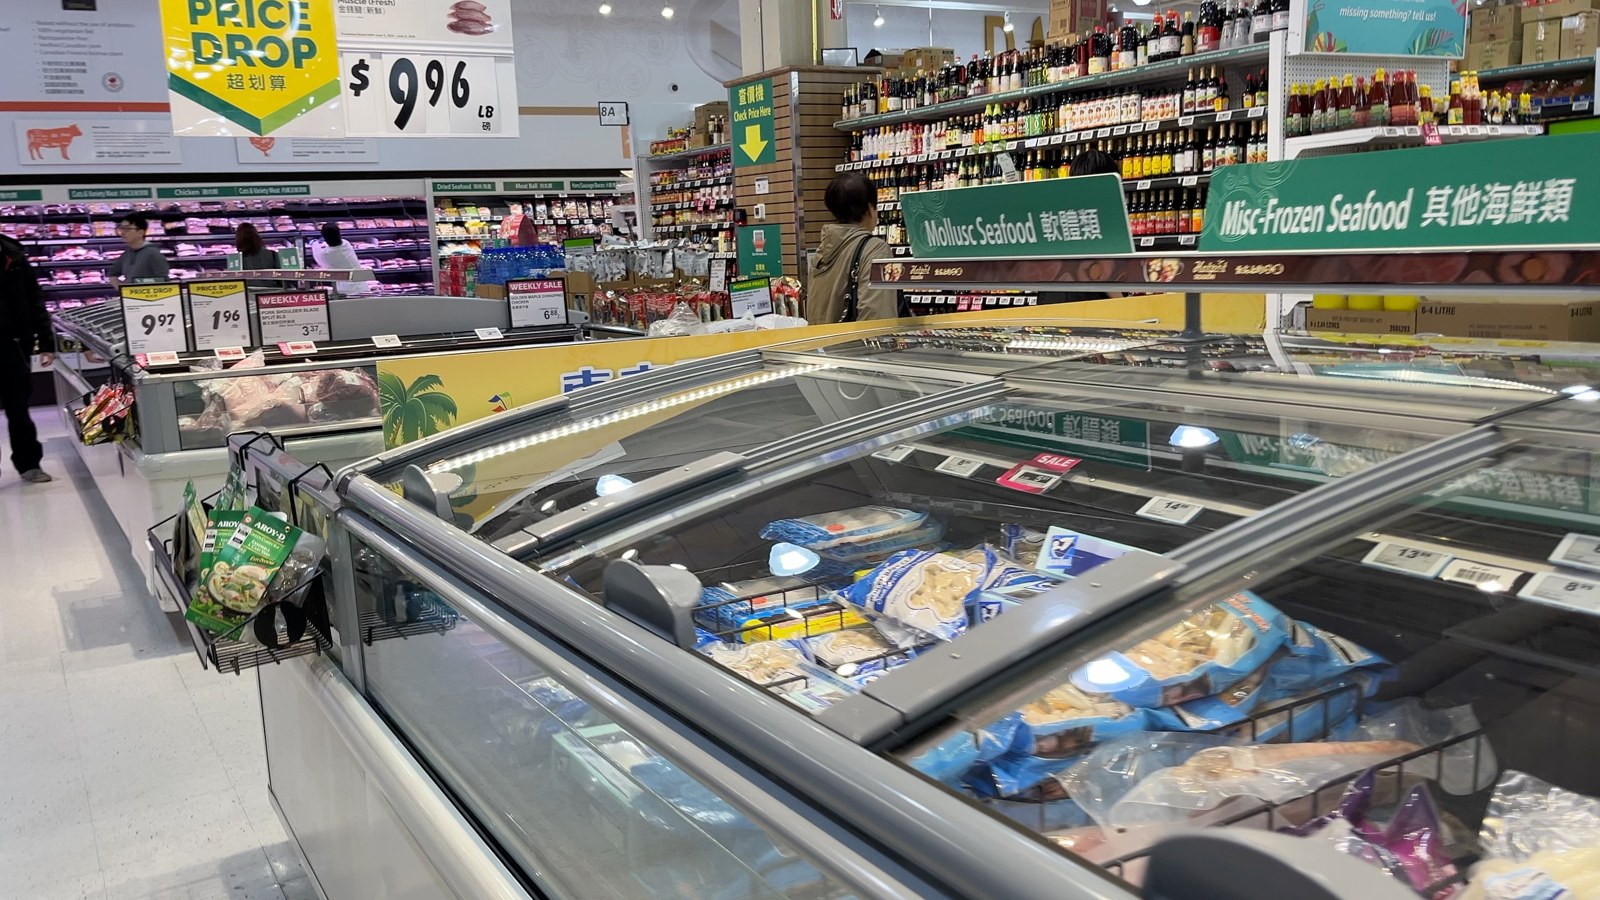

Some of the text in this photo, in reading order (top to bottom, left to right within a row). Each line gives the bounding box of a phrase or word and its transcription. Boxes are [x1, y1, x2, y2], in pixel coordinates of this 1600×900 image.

[188, 0, 312, 31] PRICE
[1340, 6, 1437, 22] missing something? tell us!
[191, 32, 317, 69] DROP
[226, 74, 287, 92] 超划算
[738, 83, 764, 106] 查價機
[478, 105, 495, 118] LB
[601, 106, 616, 117] 8A
[733, 105, 771, 122] Check Price Here
[174, 188, 200, 196] Chicken
[1219, 198, 1325, 236] Misc-Frozen
[1325, 187, 1416, 232] Seafood
[1420, 178, 1577, 228] 其他海鮮類
[925, 213, 1038, 247] Mollusc Seafood
[1039, 209, 1103, 242] 軟體類
[543, 281, 563, 289] SALE
[260, 293, 326, 305] WEEKLY SALE
[1435, 306, 1456, 316] LITRE
[1036, 455, 1076, 467] SALE
